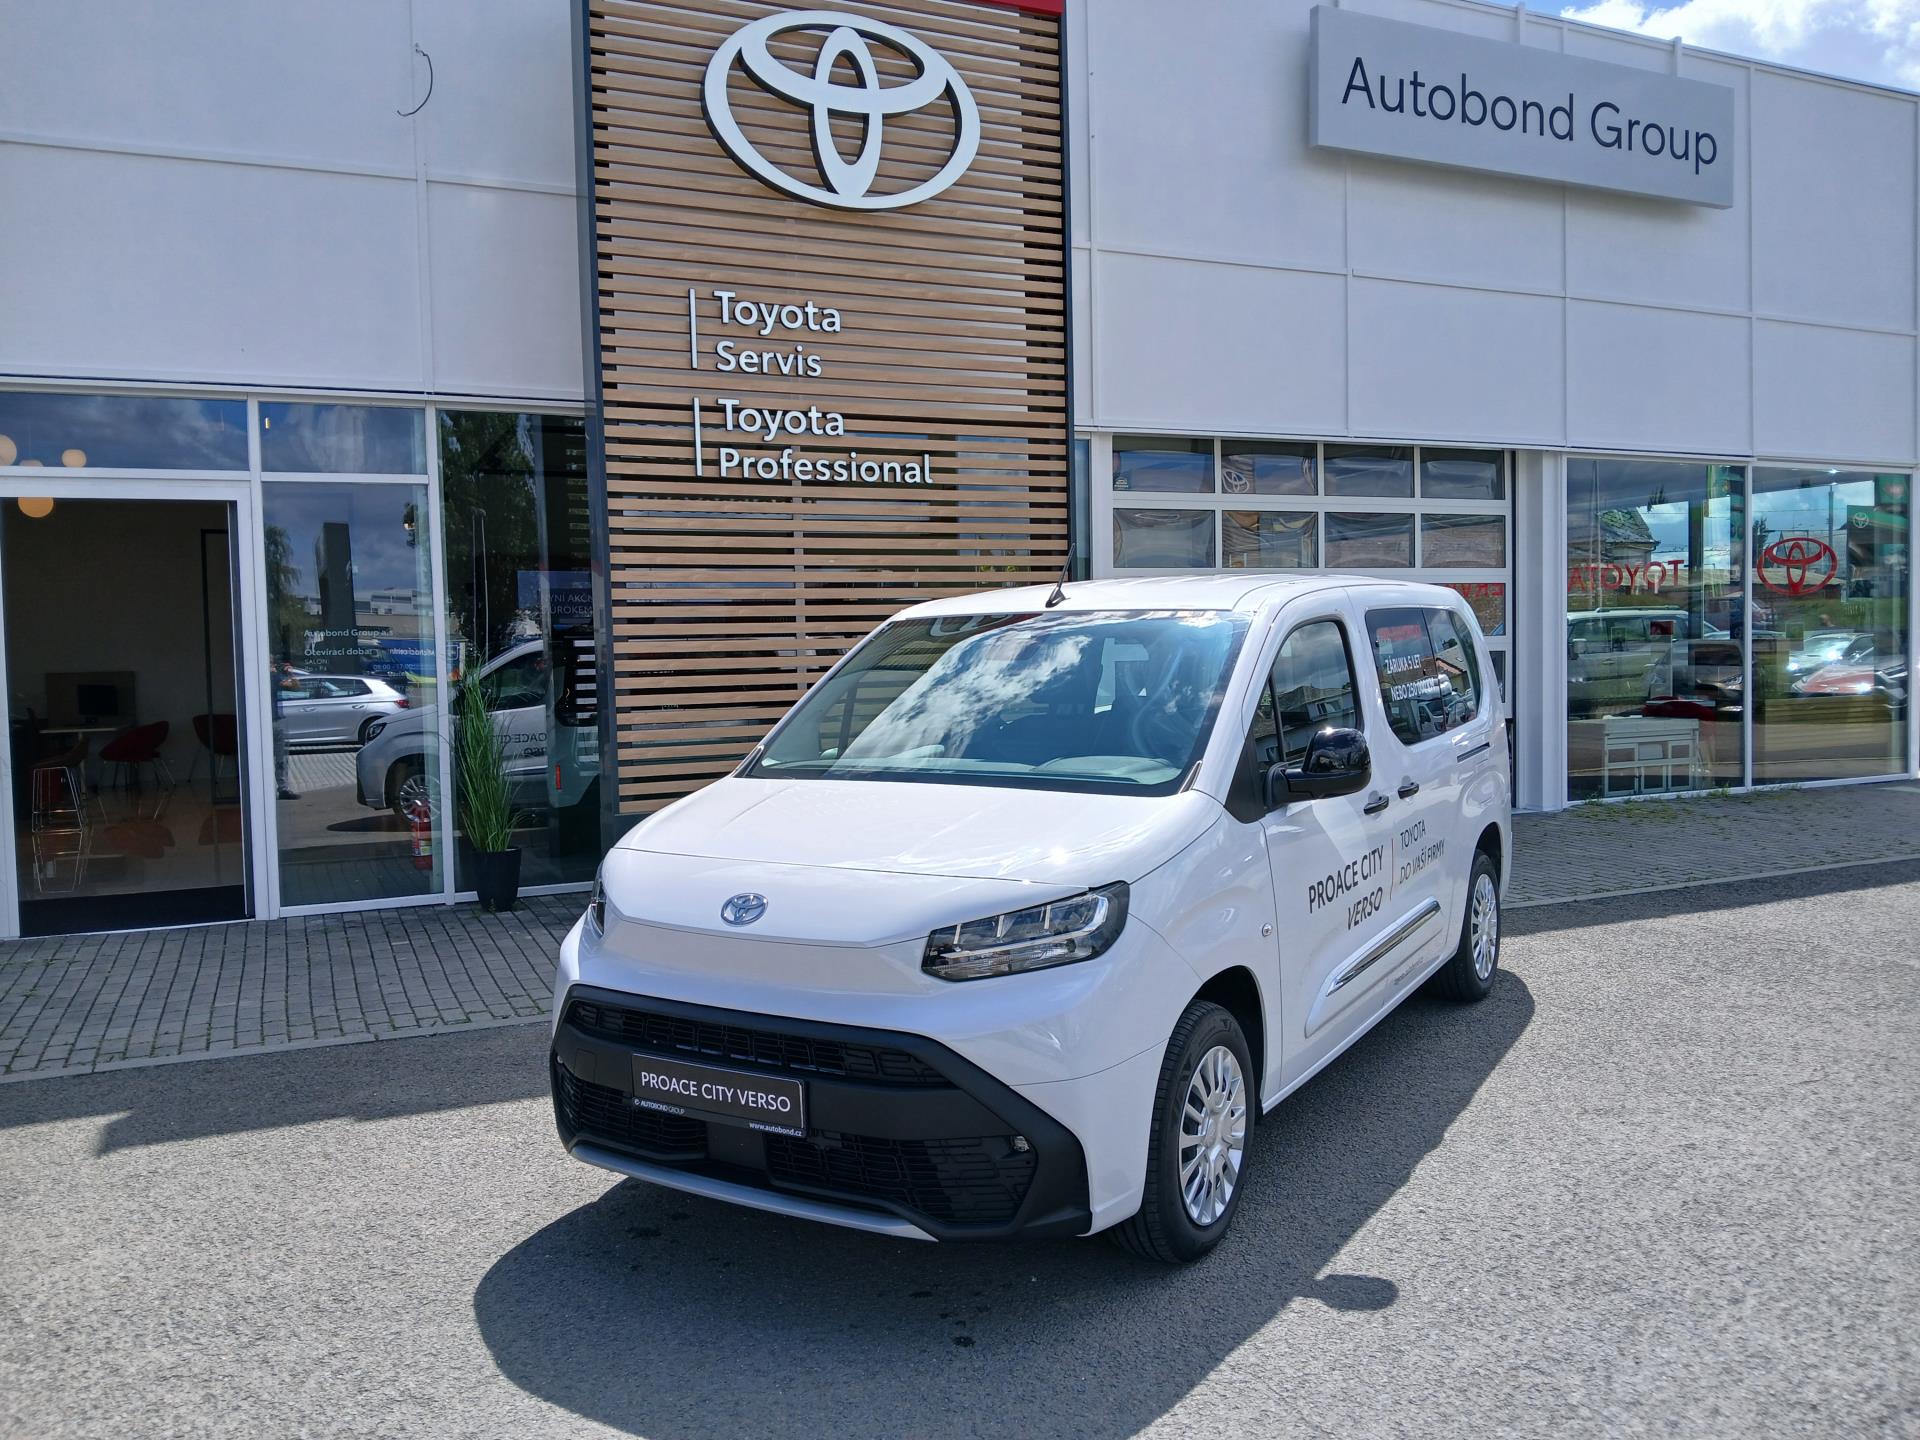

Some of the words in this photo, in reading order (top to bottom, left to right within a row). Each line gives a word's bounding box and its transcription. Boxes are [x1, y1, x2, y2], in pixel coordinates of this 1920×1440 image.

[1342, 56, 1575, 142] Autobond
[1590, 101, 1718, 175] Group
[712, 289, 842, 337] Toyota
[714, 340, 823, 378] Servis
[716, 397, 846, 442] Toyota
[718, 446, 934, 485] Professional
[351, 629, 379, 638] Group
[1391, 683, 1408, 702] NEBO
[1400, 819, 1426, 850] TOYOTA
[1308, 860, 1359, 914] PROACE
[1361, 845, 1384, 880] CITY
[1399, 862, 1411, 885] DO
[1412, 845, 1427, 877] VAŠÍ
[1427, 839, 1445, 866] FIRMY
[1348, 886, 1383, 931] VERSO
[641, 1071, 698, 1097] PROACE
[701, 1083, 734, 1103] CITY
[737, 1088, 791, 1112] VERSO
[749, 1122, 802, 1137] www.autobond.cz
